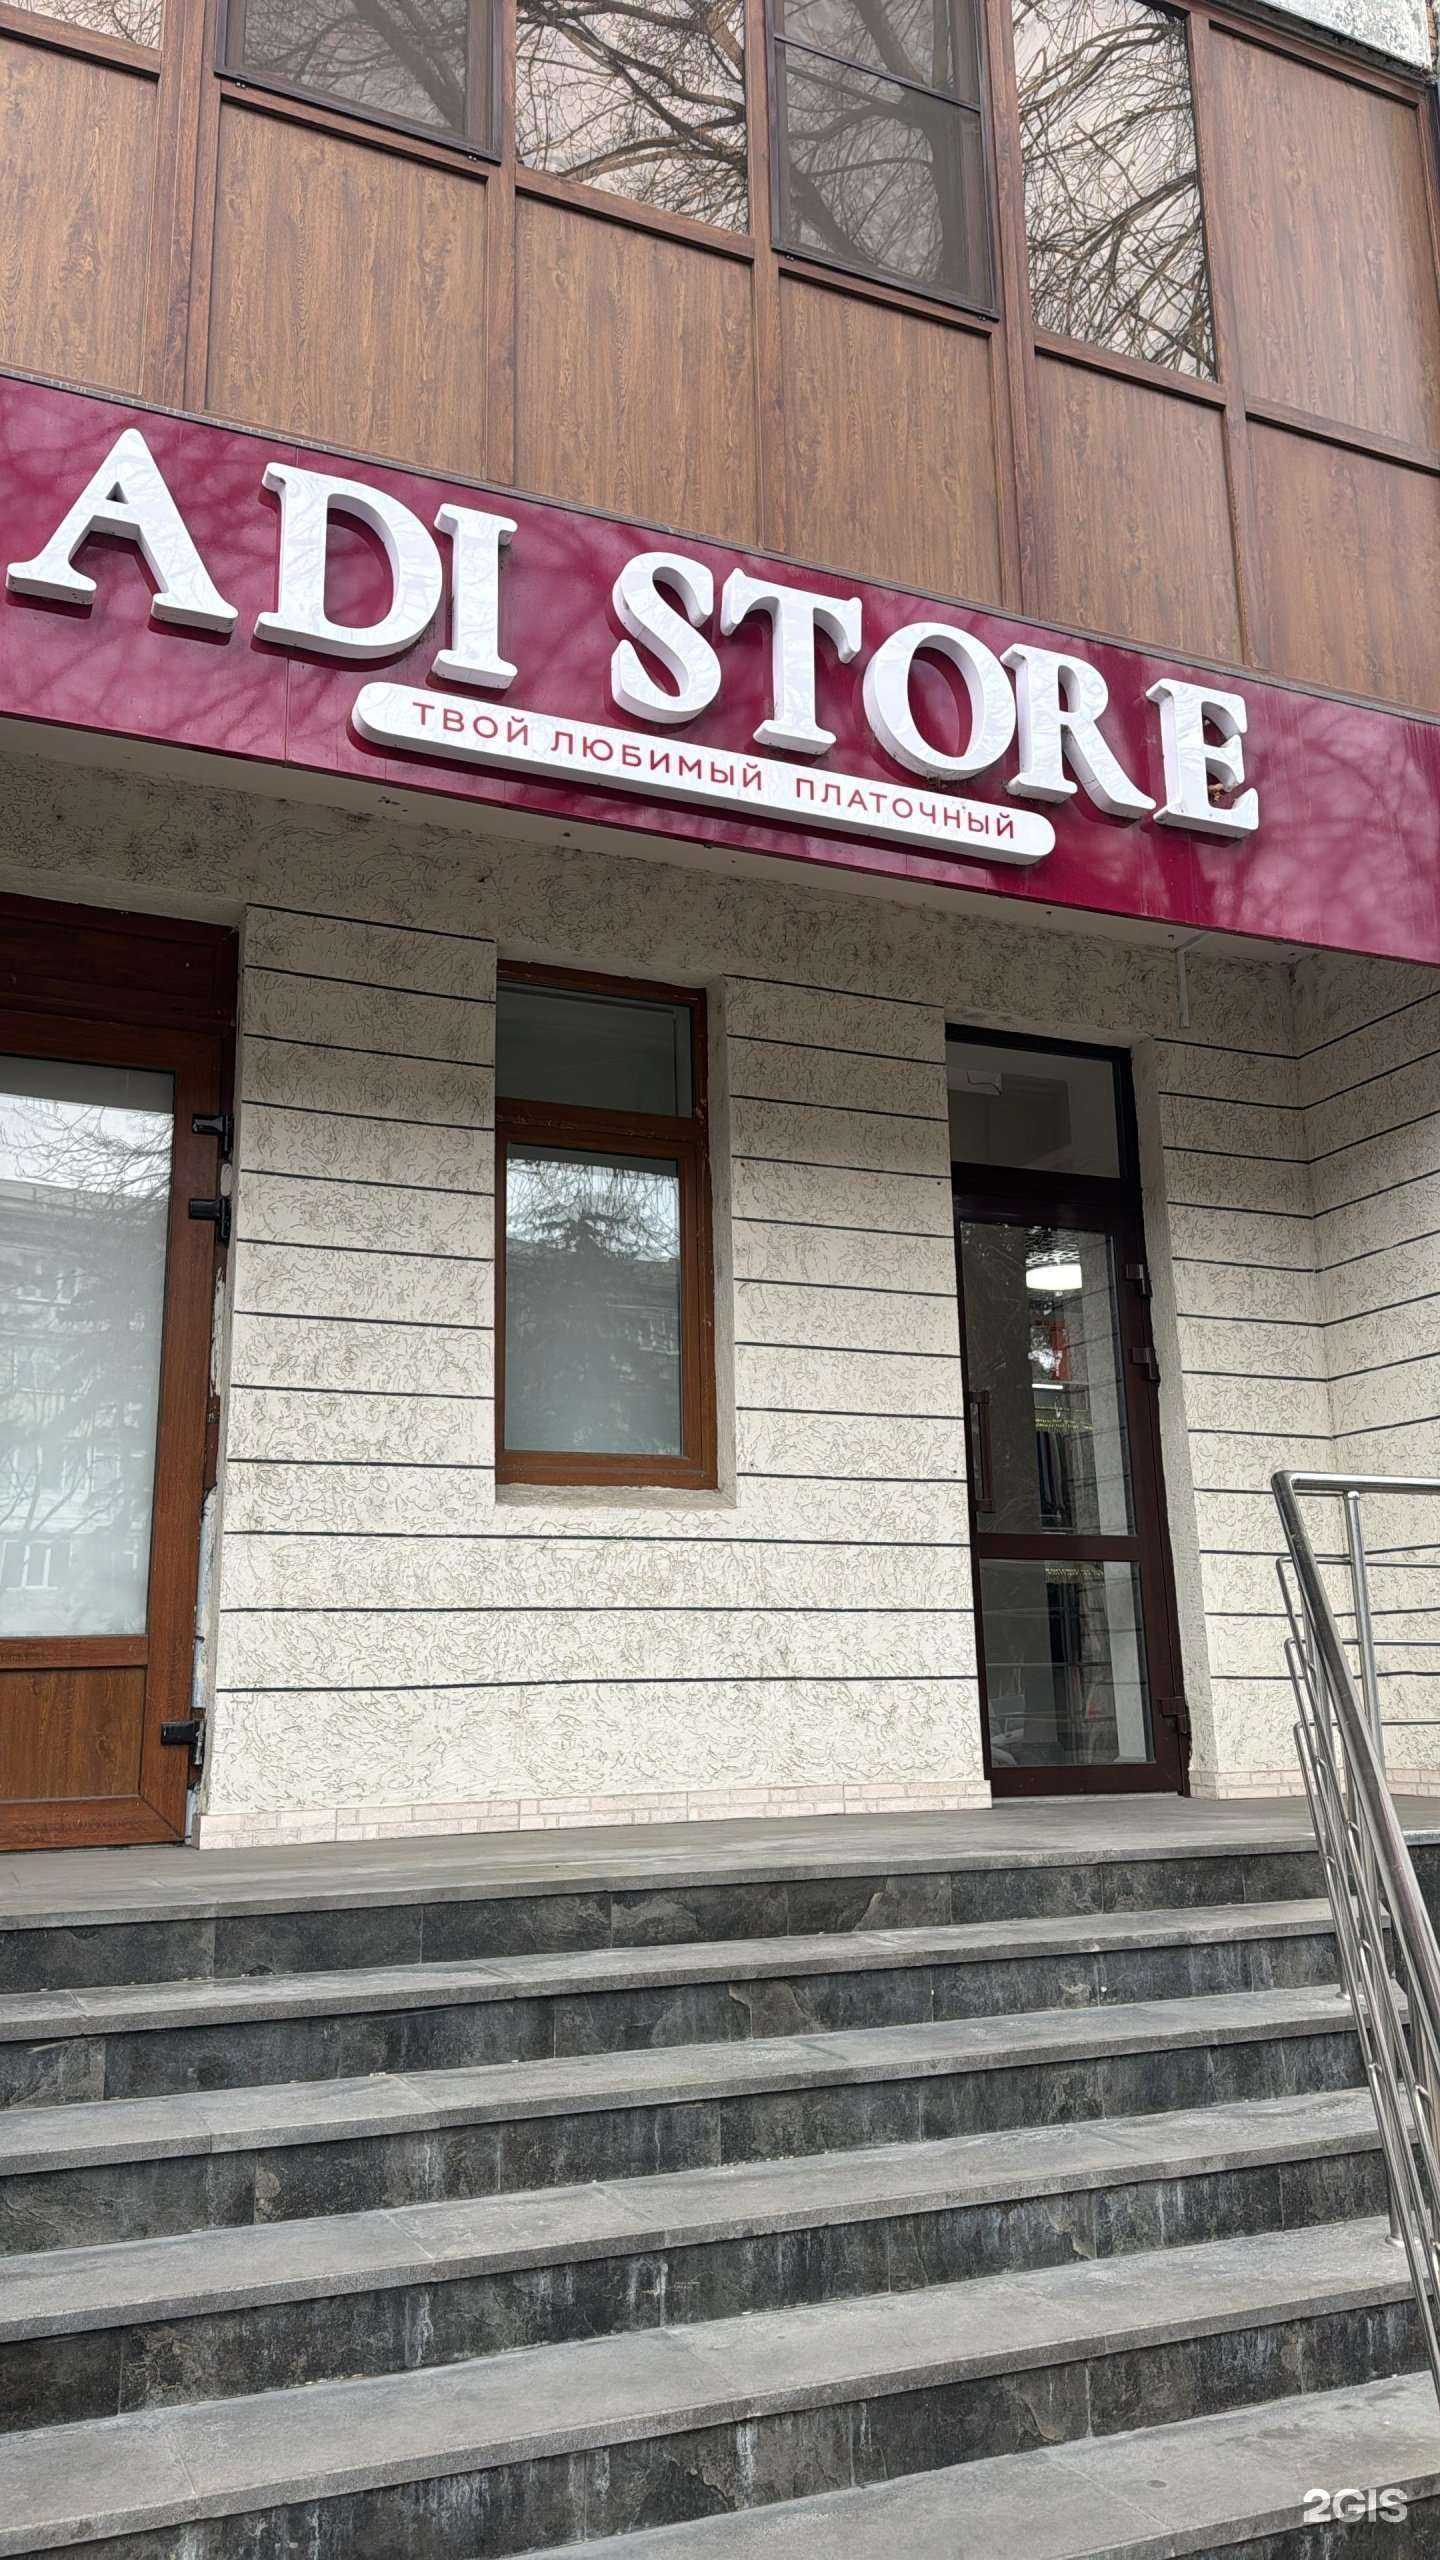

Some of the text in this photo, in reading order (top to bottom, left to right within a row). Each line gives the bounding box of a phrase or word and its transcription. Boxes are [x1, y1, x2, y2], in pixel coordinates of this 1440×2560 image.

[5, 428, 1260, 838] ADI STORE
[412, 701, 1015, 839] ТВОЙ ЛЮБИМЫЙ ПЛАТОЧНЫЙ
